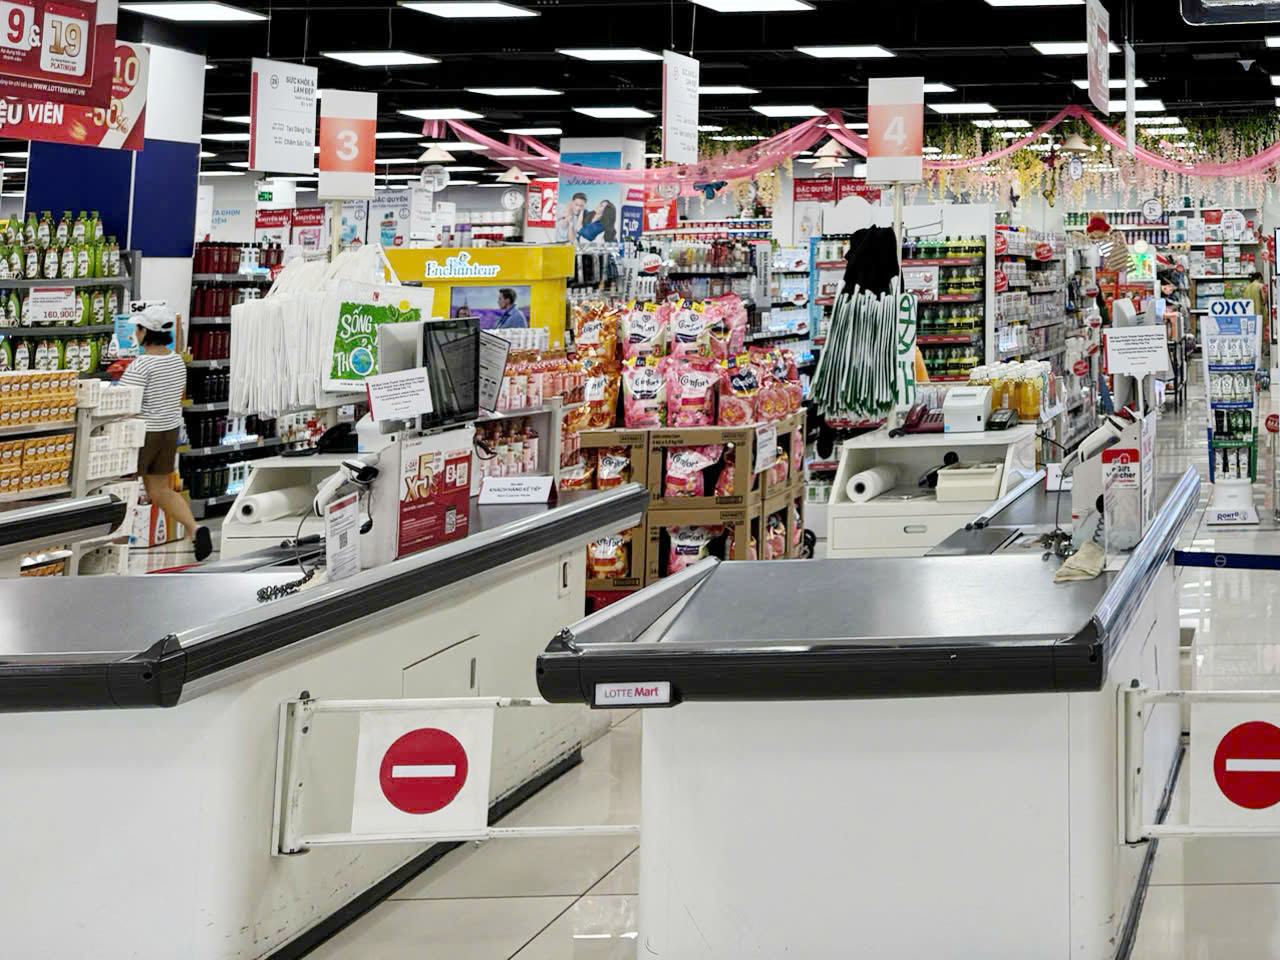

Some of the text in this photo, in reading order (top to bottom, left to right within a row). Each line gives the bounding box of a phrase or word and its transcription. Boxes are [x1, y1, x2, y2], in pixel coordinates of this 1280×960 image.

[49, 20, 82, 57] 19
[50, 62, 77, 71] PLATINUM
[28, 101, 64, 124] VIÊN
[884, 116, 906, 145] 4
[336, 130, 358, 160] 3
[426, 261, 499, 276] Enchanteur
[1211, 301, 1251, 314] OXY
[340, 306, 372, 338] SỐNG
[680, 373, 710, 386] Comfort
[605, 687, 658, 698] LOTTE Mart
